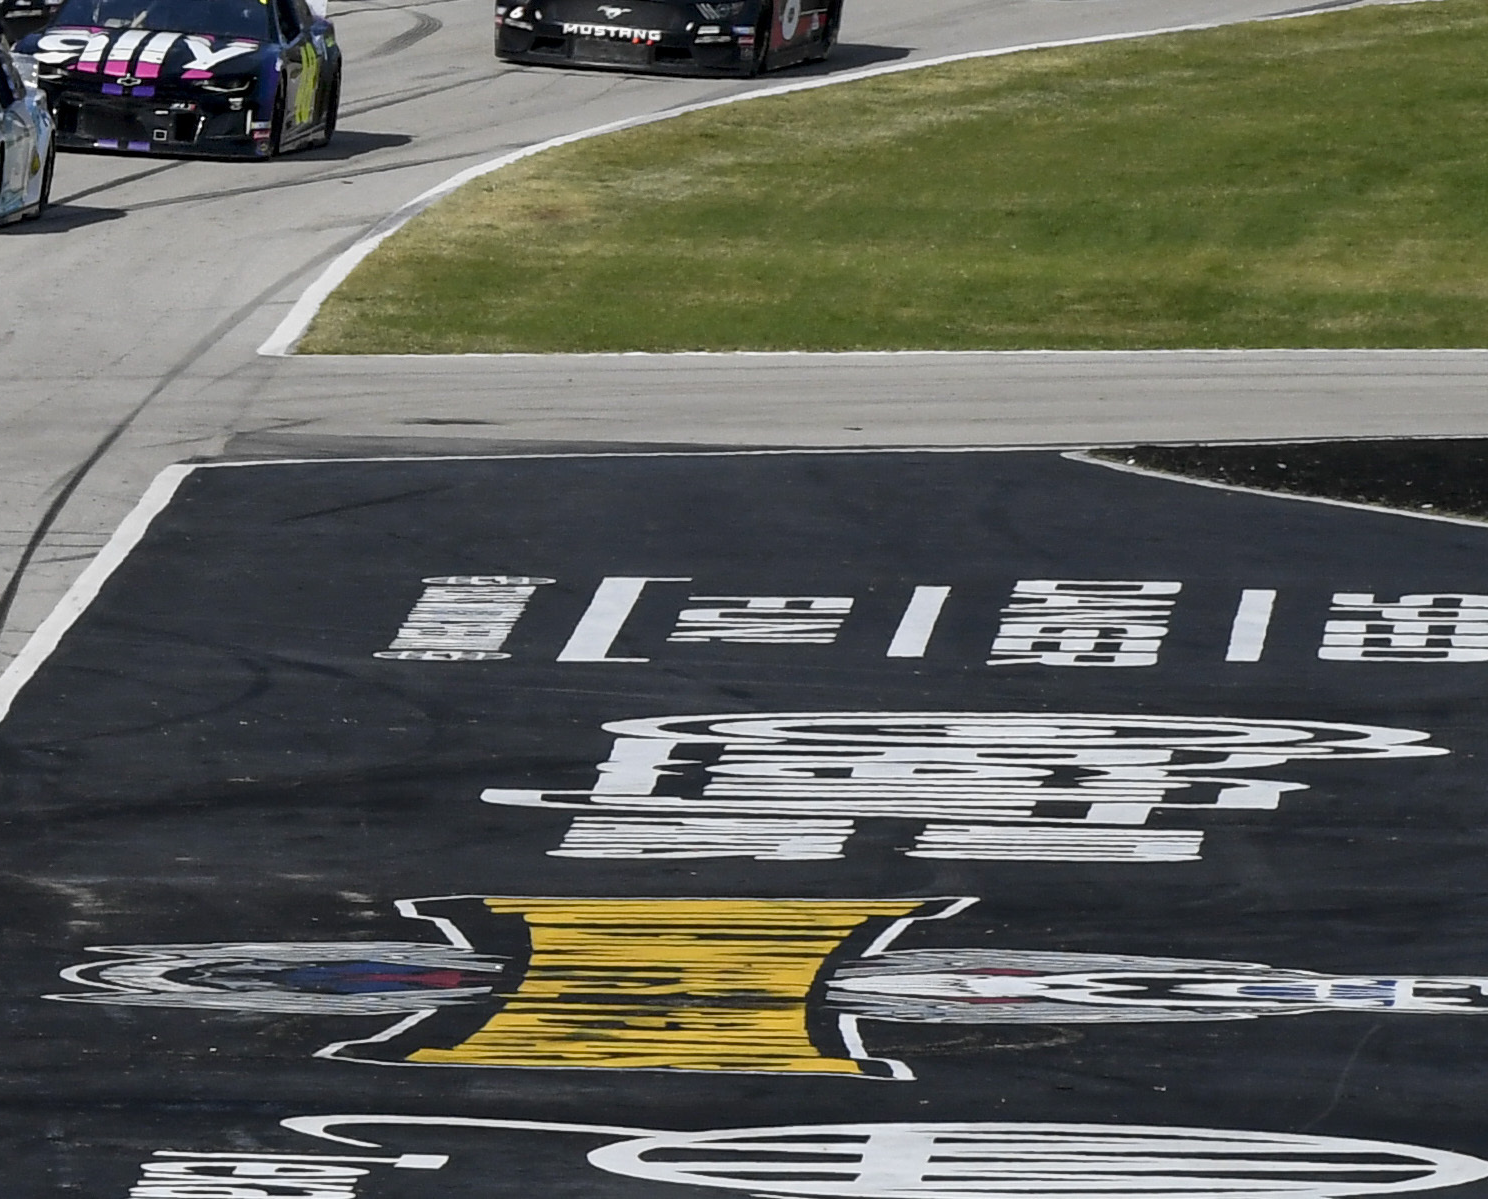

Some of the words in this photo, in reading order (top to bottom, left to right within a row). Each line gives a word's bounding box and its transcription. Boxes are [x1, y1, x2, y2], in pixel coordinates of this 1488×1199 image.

[33, 30, 260, 72] ally
[562, 22, 661, 41] MUSTANG
[987, 580, 1182, 667] DANGER
[128, 1150, 450, 1199] Texa
